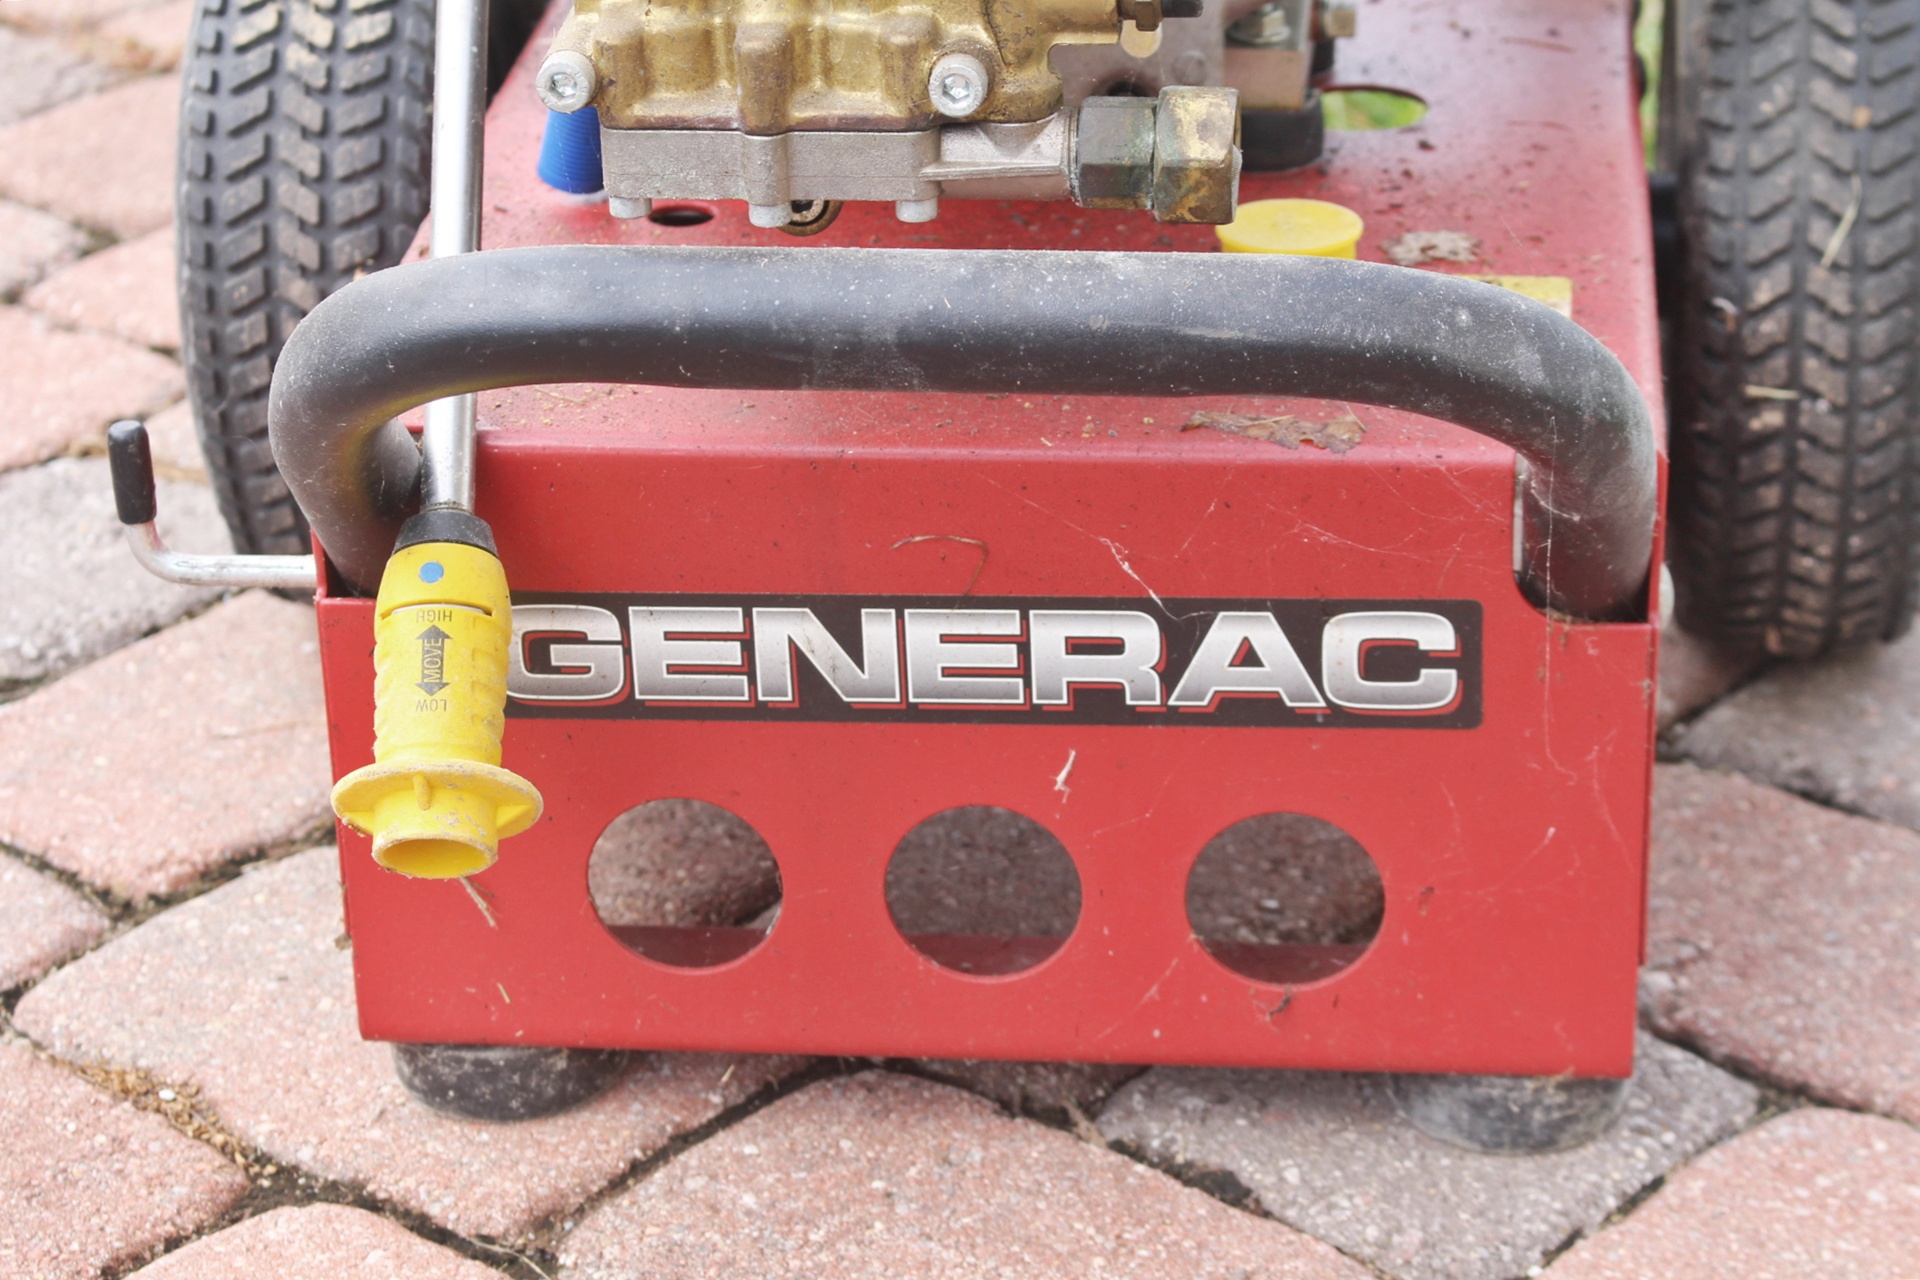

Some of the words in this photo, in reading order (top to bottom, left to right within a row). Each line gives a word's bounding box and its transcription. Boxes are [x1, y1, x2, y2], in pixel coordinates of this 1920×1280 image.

[415, 609, 453, 623] HIGH
[423, 637, 442, 683] MOVE
[505, 603, 1464, 716] GENERAC
[415, 698, 447, 712] LOW
